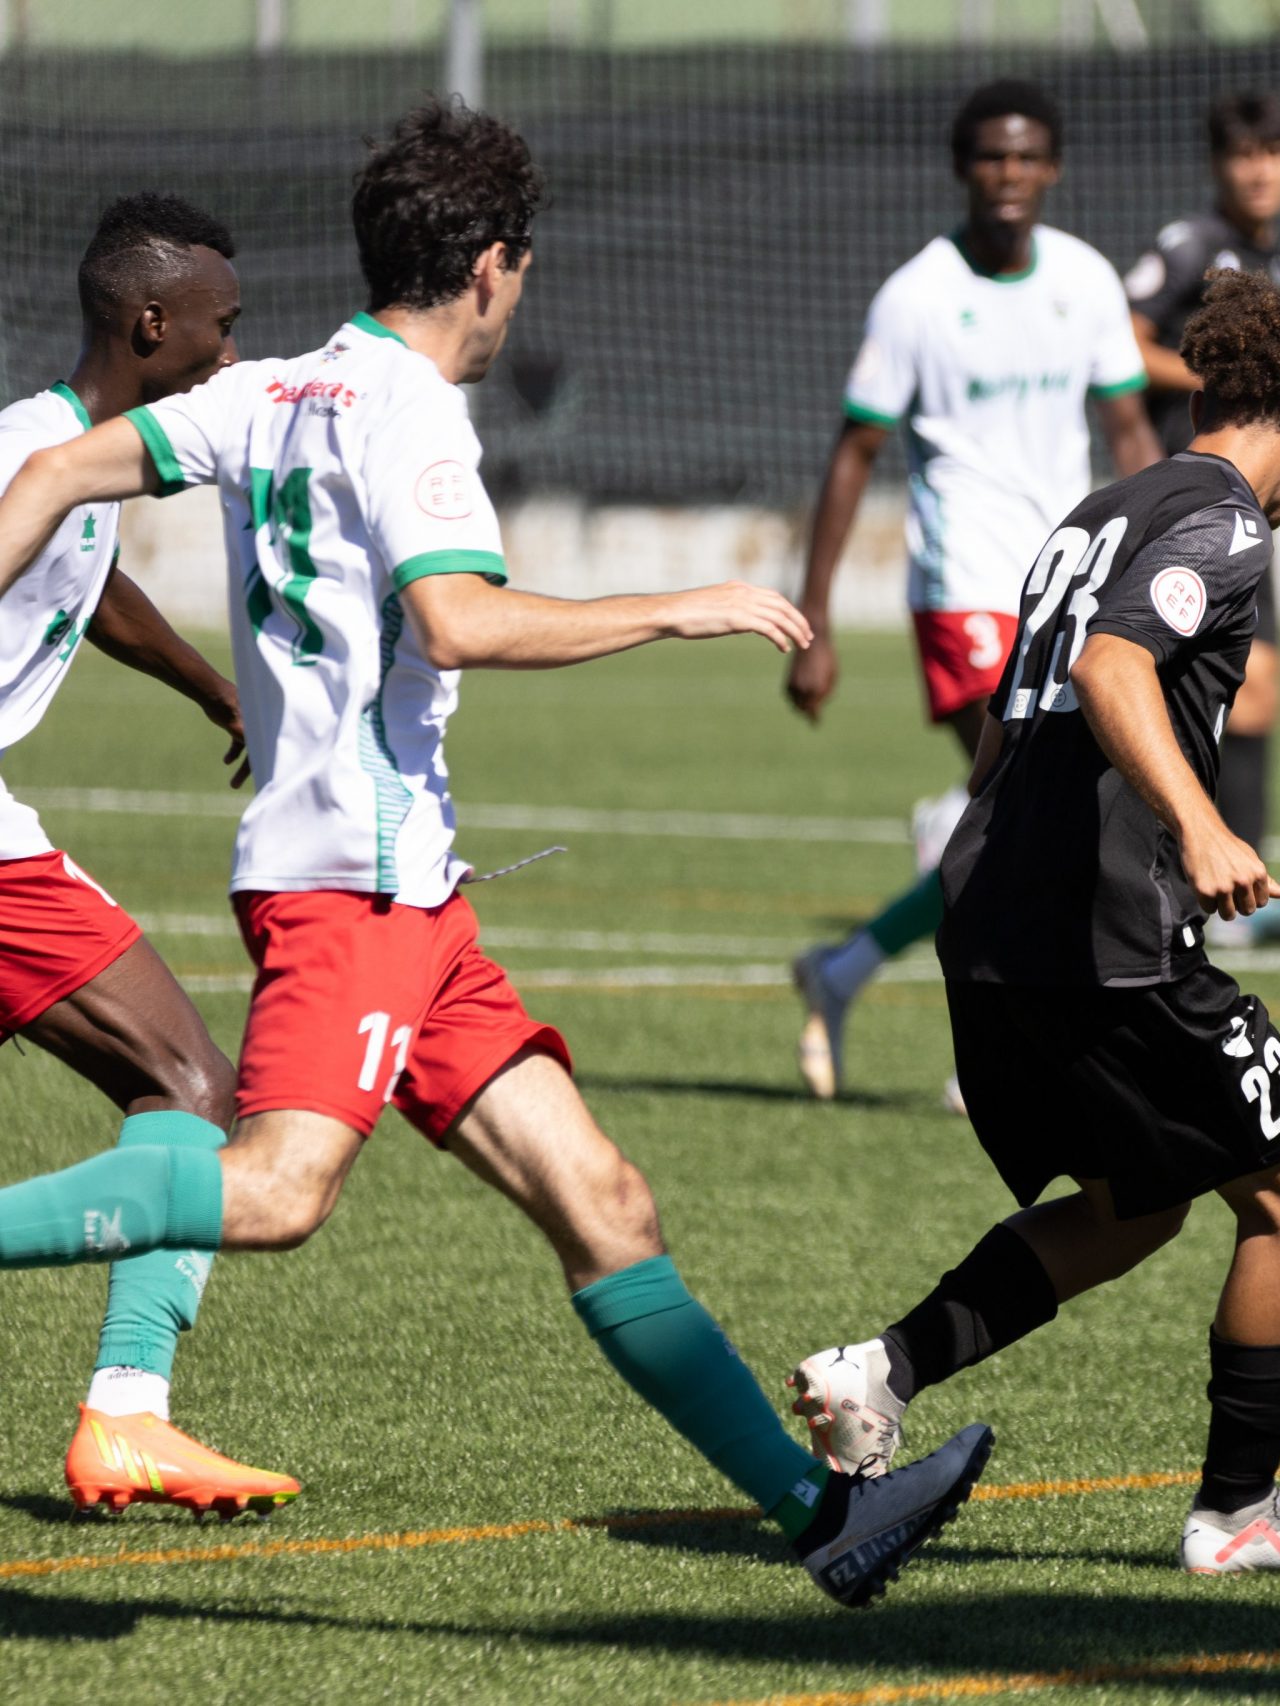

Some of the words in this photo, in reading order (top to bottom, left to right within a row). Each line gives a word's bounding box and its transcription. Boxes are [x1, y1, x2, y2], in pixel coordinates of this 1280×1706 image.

[963, 610, 1003, 671] 3
[1002, 516, 1128, 721] 23
[357, 1010, 413, 1103] 11
